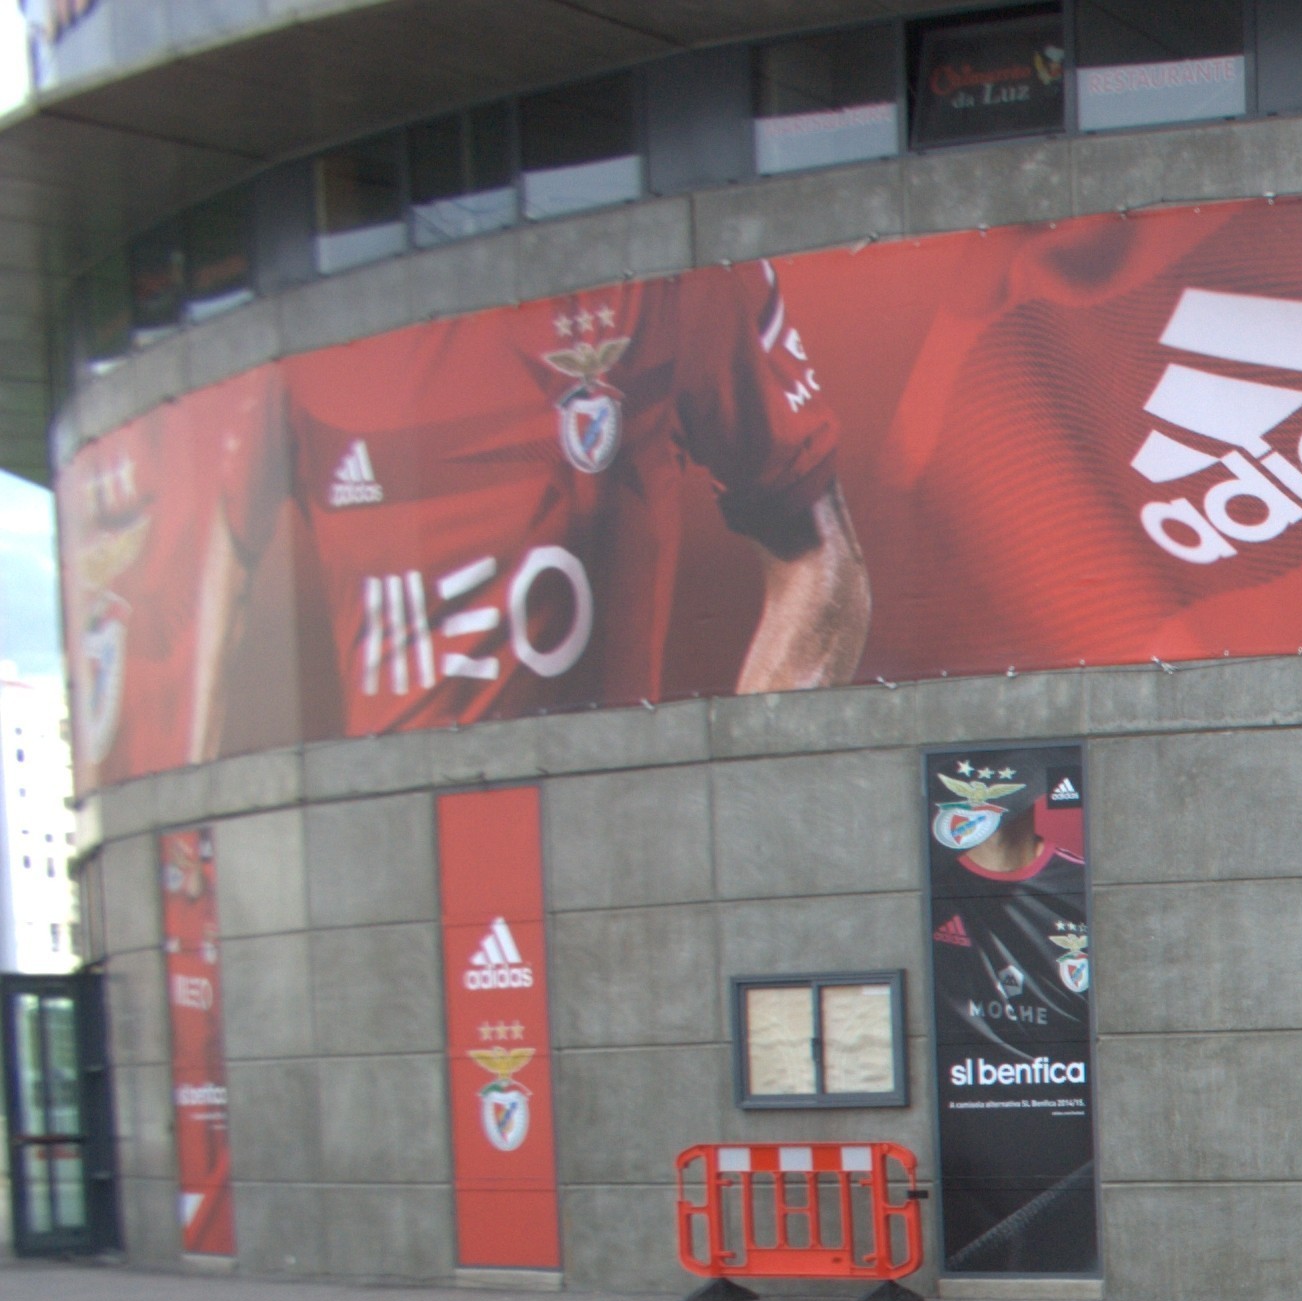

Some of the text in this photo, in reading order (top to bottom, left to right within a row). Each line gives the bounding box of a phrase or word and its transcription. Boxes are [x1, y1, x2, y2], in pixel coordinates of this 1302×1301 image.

[363, 545, 594, 693] MEO
[463, 963, 534, 990] adidas
[969, 999, 1049, 1025] MOCHE
[951, 1056, 1086, 1086] sl benfica
